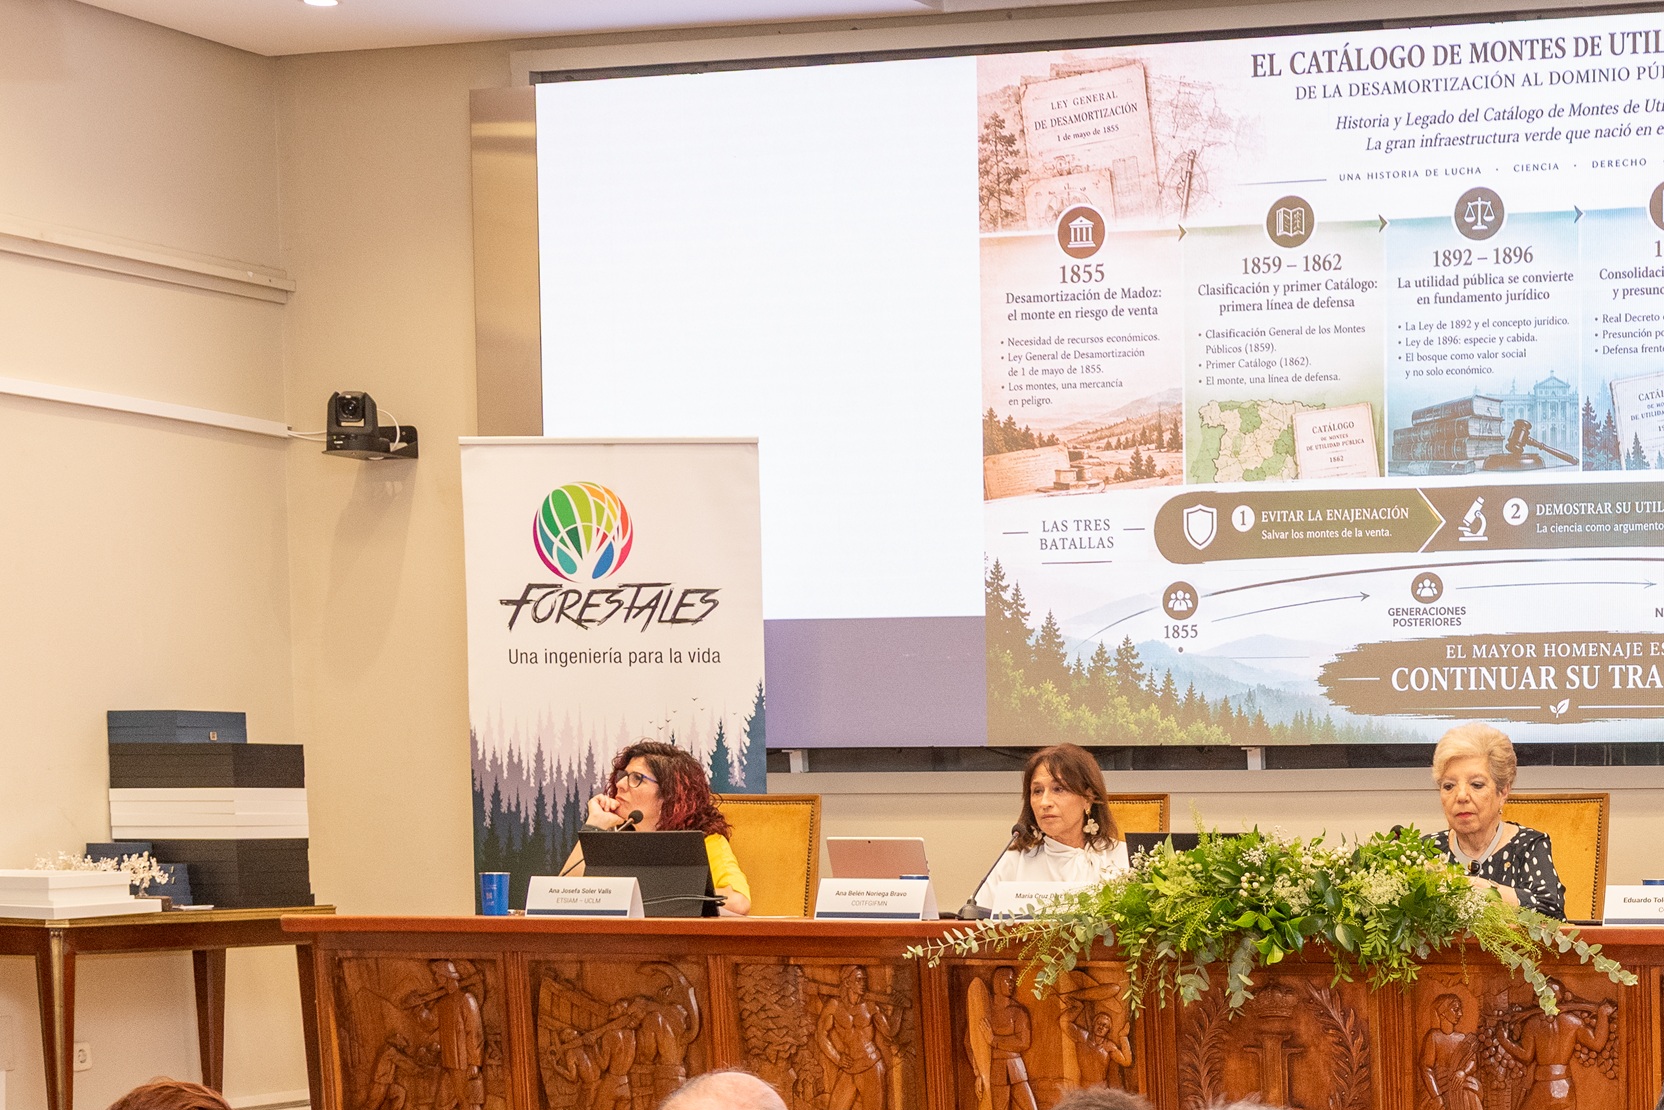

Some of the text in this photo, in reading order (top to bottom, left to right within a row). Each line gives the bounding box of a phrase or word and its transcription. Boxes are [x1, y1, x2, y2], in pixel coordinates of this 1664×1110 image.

[1250, 53, 1281, 77] EL
[1289, 41, 1425, 75] CATÁLOGO
[1432, 43, 1461, 65] DE
[1469, 36, 1566, 63] MONTES
[1573, 35, 1602, 57] DE
[1295, 85, 1316, 99] DE
[1322, 84, 1342, 98] LA
[1348, 70, 1514, 96] DESAMORTIZACIÓN
[1521, 72, 1543, 86] AL
[1549, 67, 1630, 85] DOMINIO
[1050, 90, 1117, 110] LEY GENERAL
[1034, 101, 1137, 130] DE DESAMORTIZACIÓN
[1338, 173, 1361, 181] UNA
[1366, 169, 1418, 179] HISTORIA
[1425, 168, 1438, 176] DE
[1444, 166, 1481, 175] LUCHA
[1512, 162, 1558, 172] CIENCIA
[1591, 157, 1646, 168] DERECHO
[1242, 253, 1342, 274] 1859 1862
[1433, 245, 1533, 267] 1892 1896
[1060, 263, 1104, 283] 1855
[1005, 286, 1161, 303] Desamortización de Madoz:
[1416, 288, 1550, 305] en fundamento jurídico
[1602, 313, 1621, 323] Real
[1624, 312, 1660, 322] Decreto
[1007, 333, 1159, 346] Necesidad de recursos económicos.
[1205, 324, 1365, 338] Clasificación General de los Montes
[1405, 348, 1526, 363] El bosque como valor social
[1261, 504, 1408, 522] EVITAR LA ENAJENACIÓN
[1042, 518, 1110, 532] LAS TRES
[1039, 536, 1113, 550] BATALLAS
[498, 582, 722, 633] FORESTALES
[508, 647, 720, 667] Una ingeniería para la vida
[1391, 665, 1557, 691] CONTINUAR
[1566, 664, 1600, 689] SU
